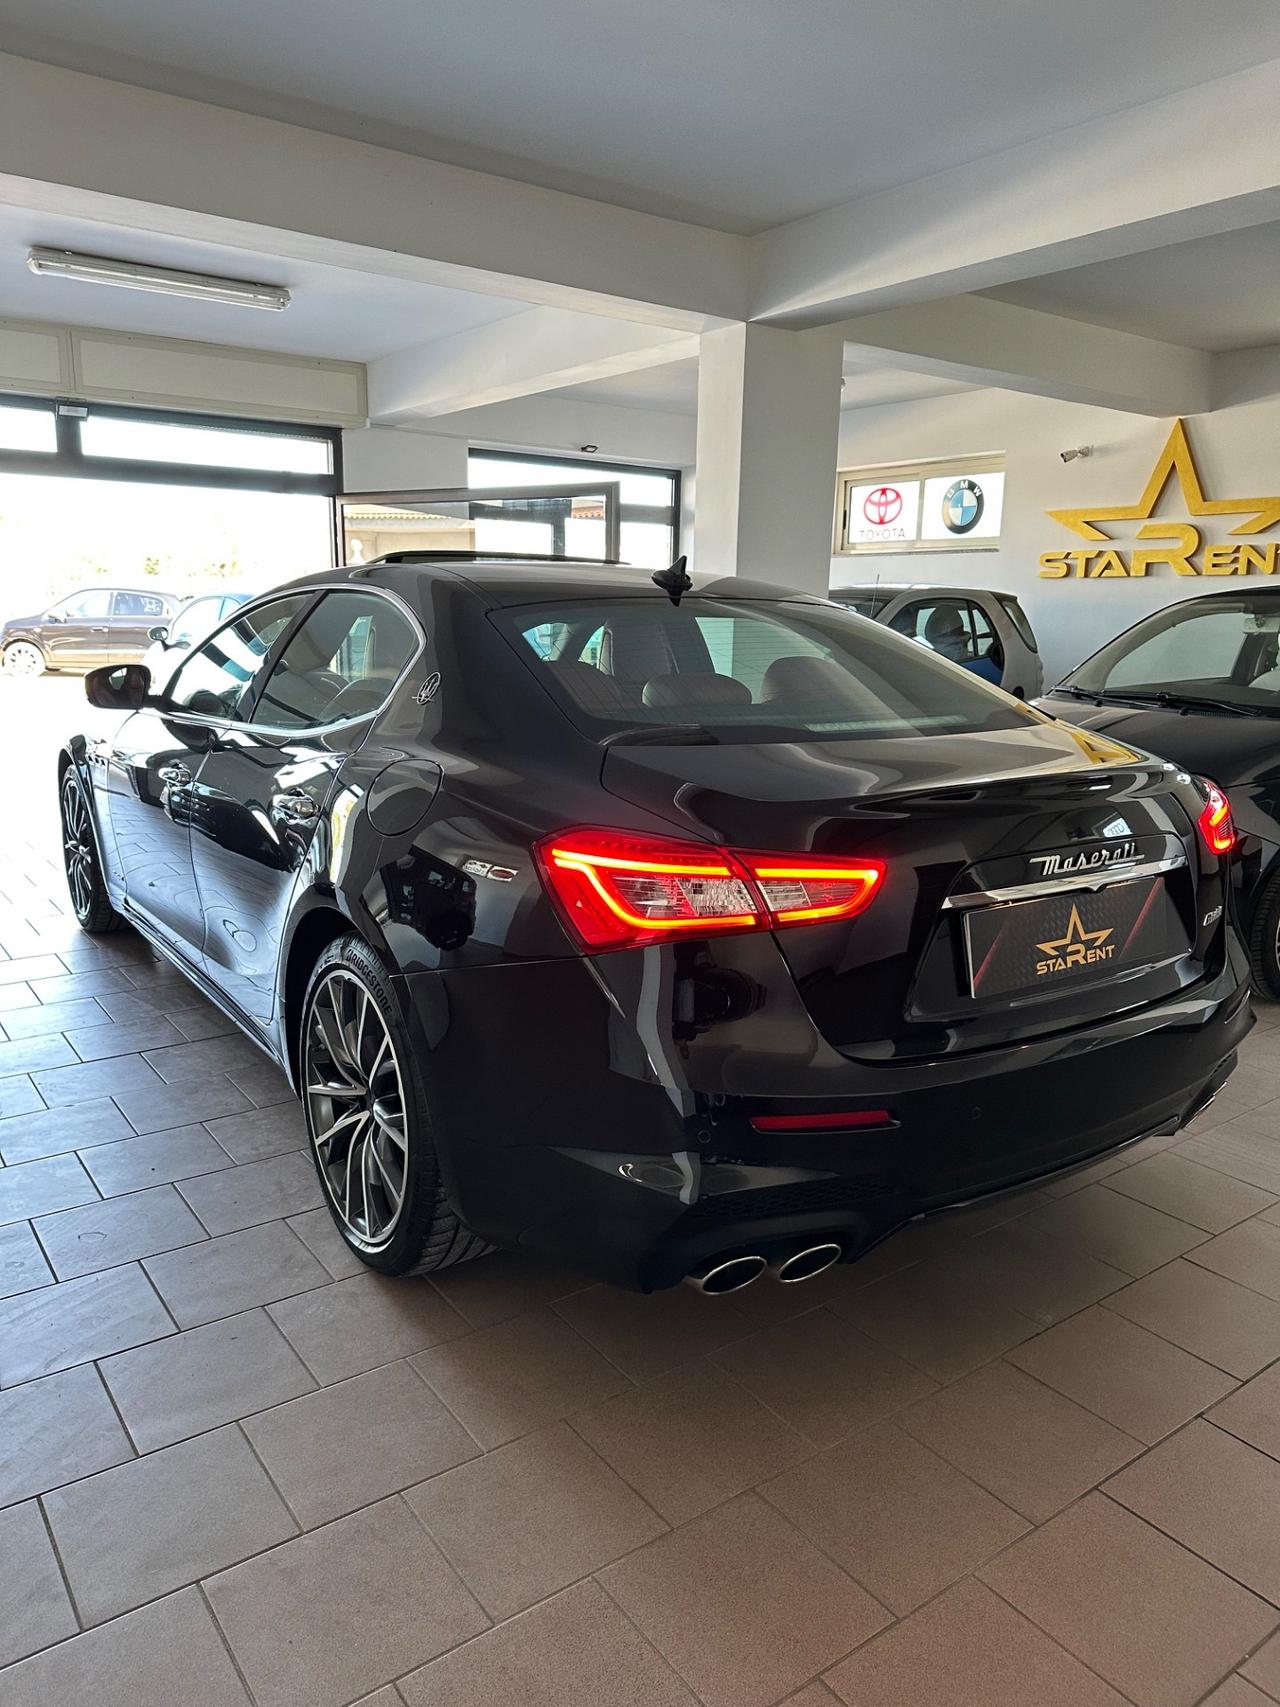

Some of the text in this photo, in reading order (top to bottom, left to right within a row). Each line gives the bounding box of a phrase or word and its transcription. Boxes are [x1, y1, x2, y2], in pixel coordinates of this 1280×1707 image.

[947, 480, 983, 497] BMW
[859, 528, 906, 540] TOYOTA
[1040, 523, 1280, 577] STAREN
[1029, 842, 1145, 875] Maserati
[346, 949, 393, 1016] BRIDGESTONE
